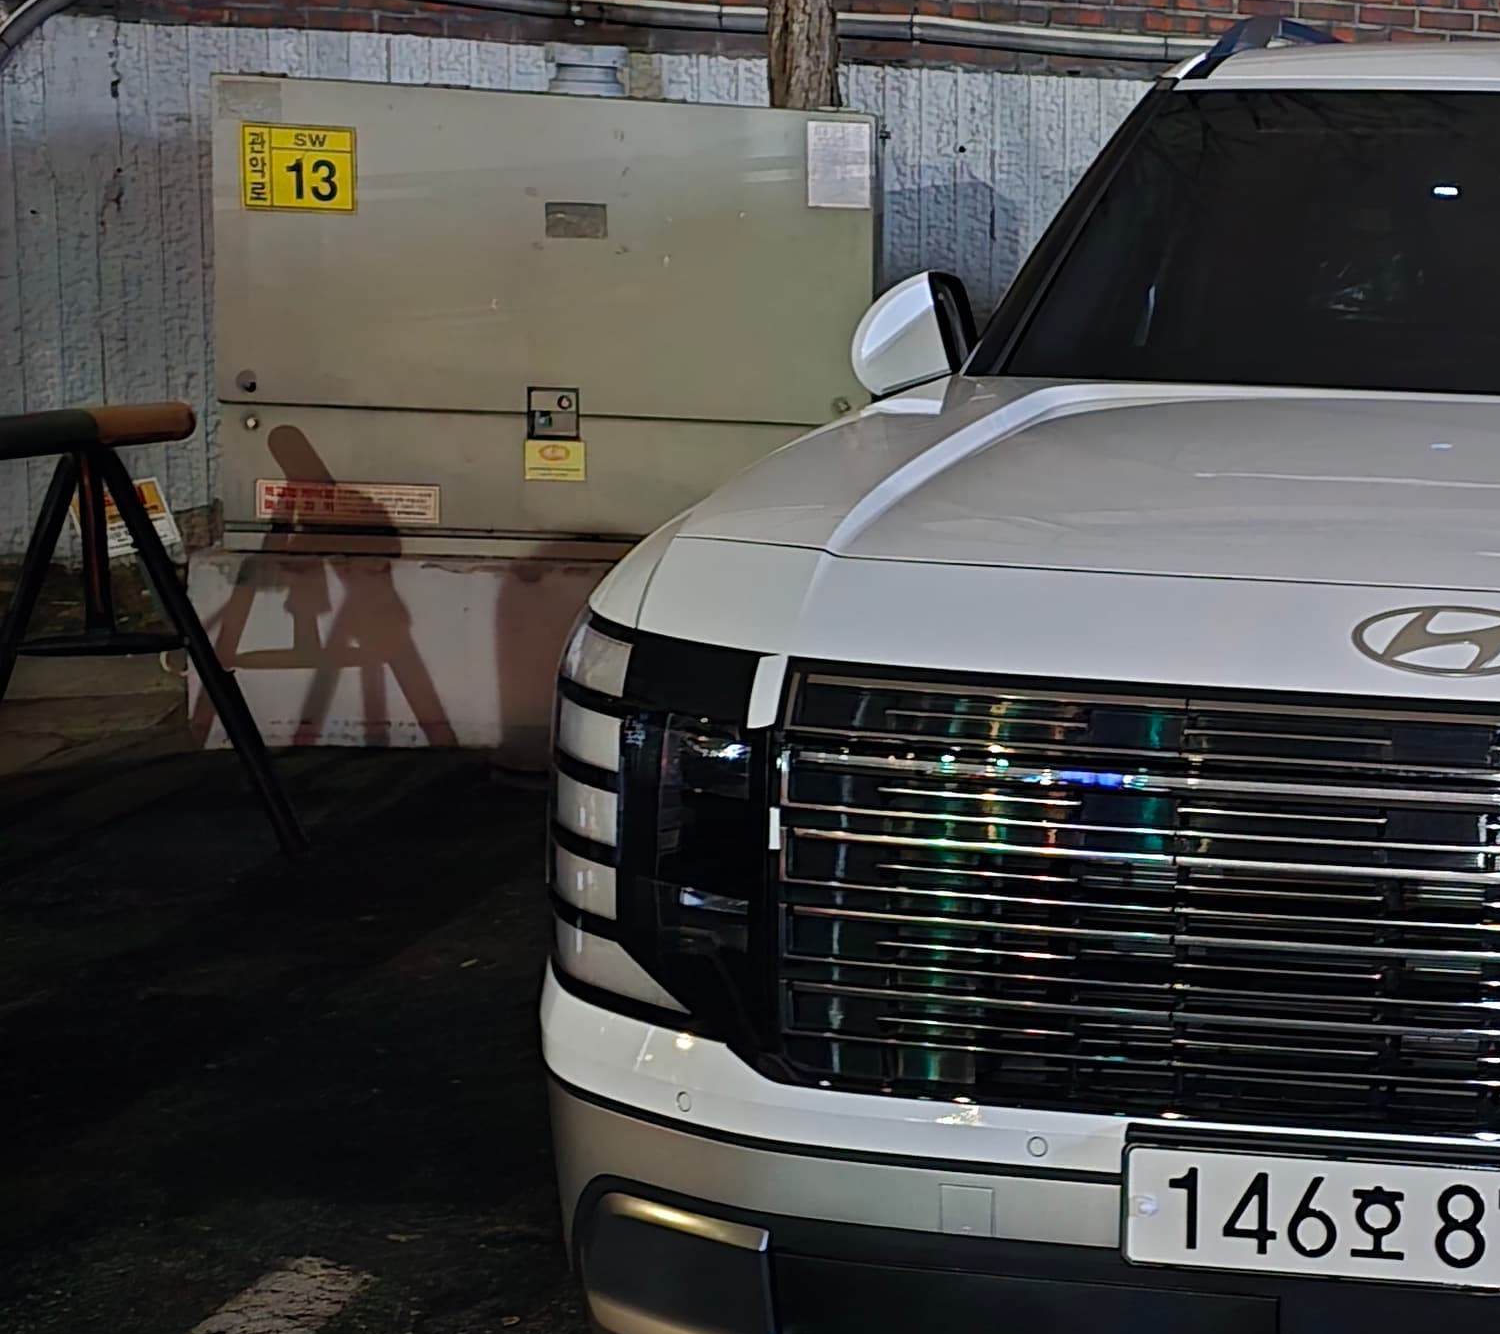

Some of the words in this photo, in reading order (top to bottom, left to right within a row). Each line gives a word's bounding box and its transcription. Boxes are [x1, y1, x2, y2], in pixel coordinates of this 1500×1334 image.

[294, 134, 327, 147] SW
[286, 158, 338, 201] 13
[1168, 1166, 1405, 1261] 146호
